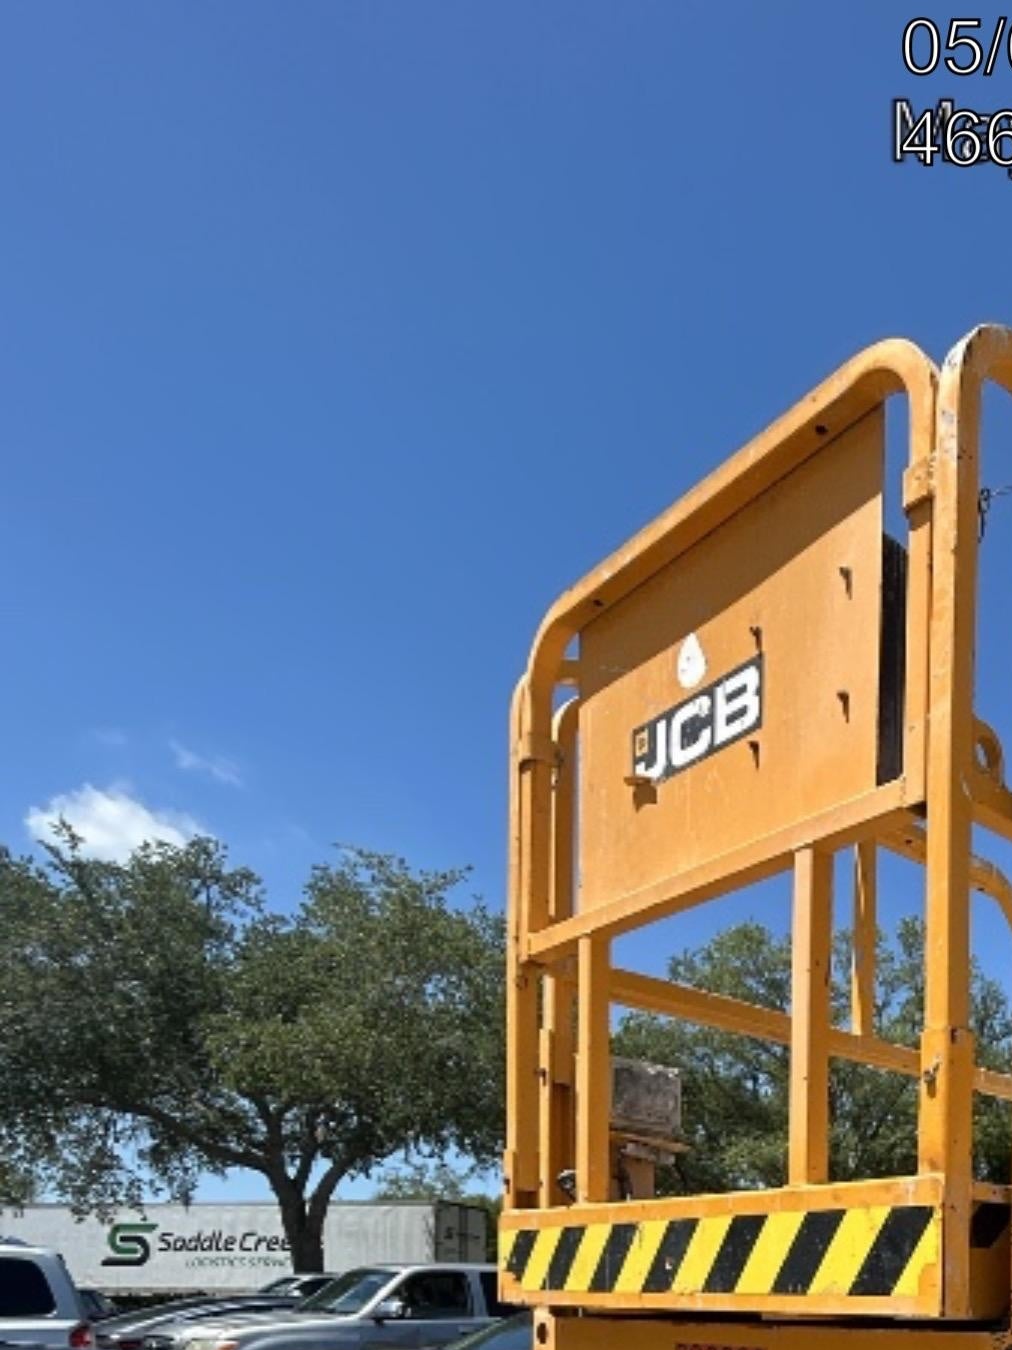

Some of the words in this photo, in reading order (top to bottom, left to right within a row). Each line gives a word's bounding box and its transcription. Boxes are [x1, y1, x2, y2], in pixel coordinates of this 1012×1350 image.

[633, 664, 760, 780] JCB
[158, 1229, 237, 1252] Saddle
[239, 1231, 293, 1252] Cree
